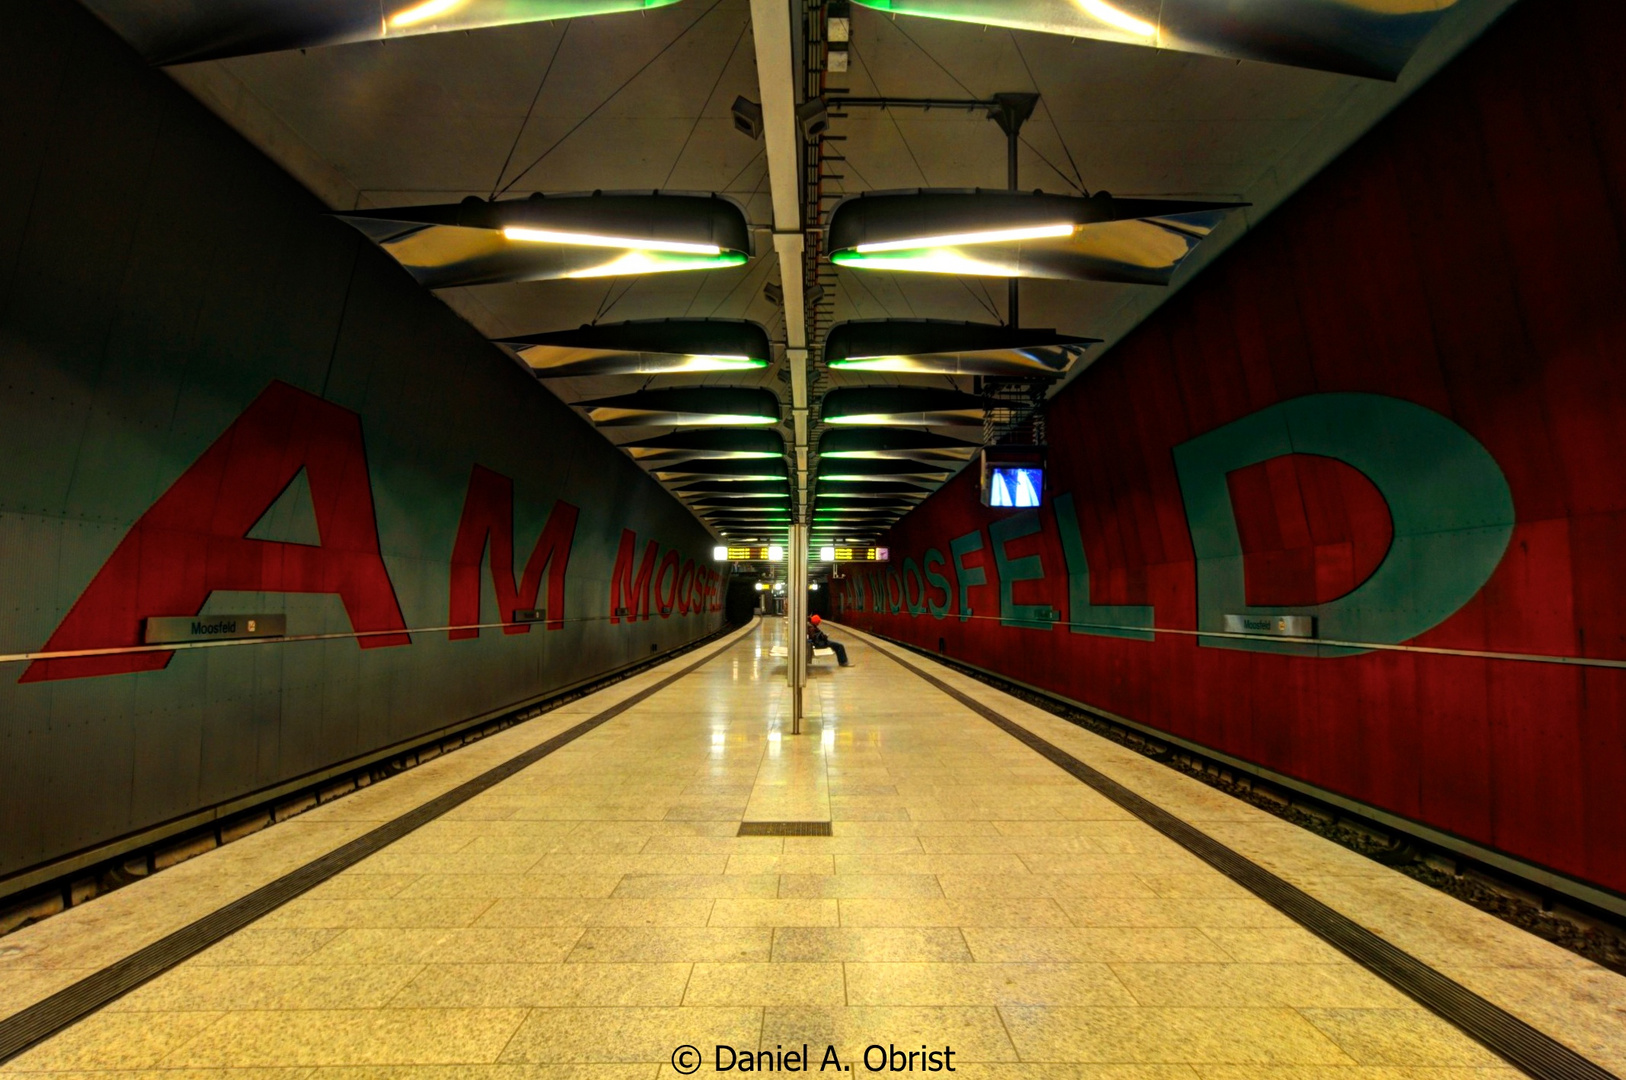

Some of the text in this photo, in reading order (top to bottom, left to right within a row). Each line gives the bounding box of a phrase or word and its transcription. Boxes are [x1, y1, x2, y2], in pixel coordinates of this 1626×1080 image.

[18, 378, 580, 683] AM
[868, 391, 1517, 659] MOOSFELD
[191, 621, 236, 635] Moosfeld
[1243, 619, 1271, 630] Moosfeld
